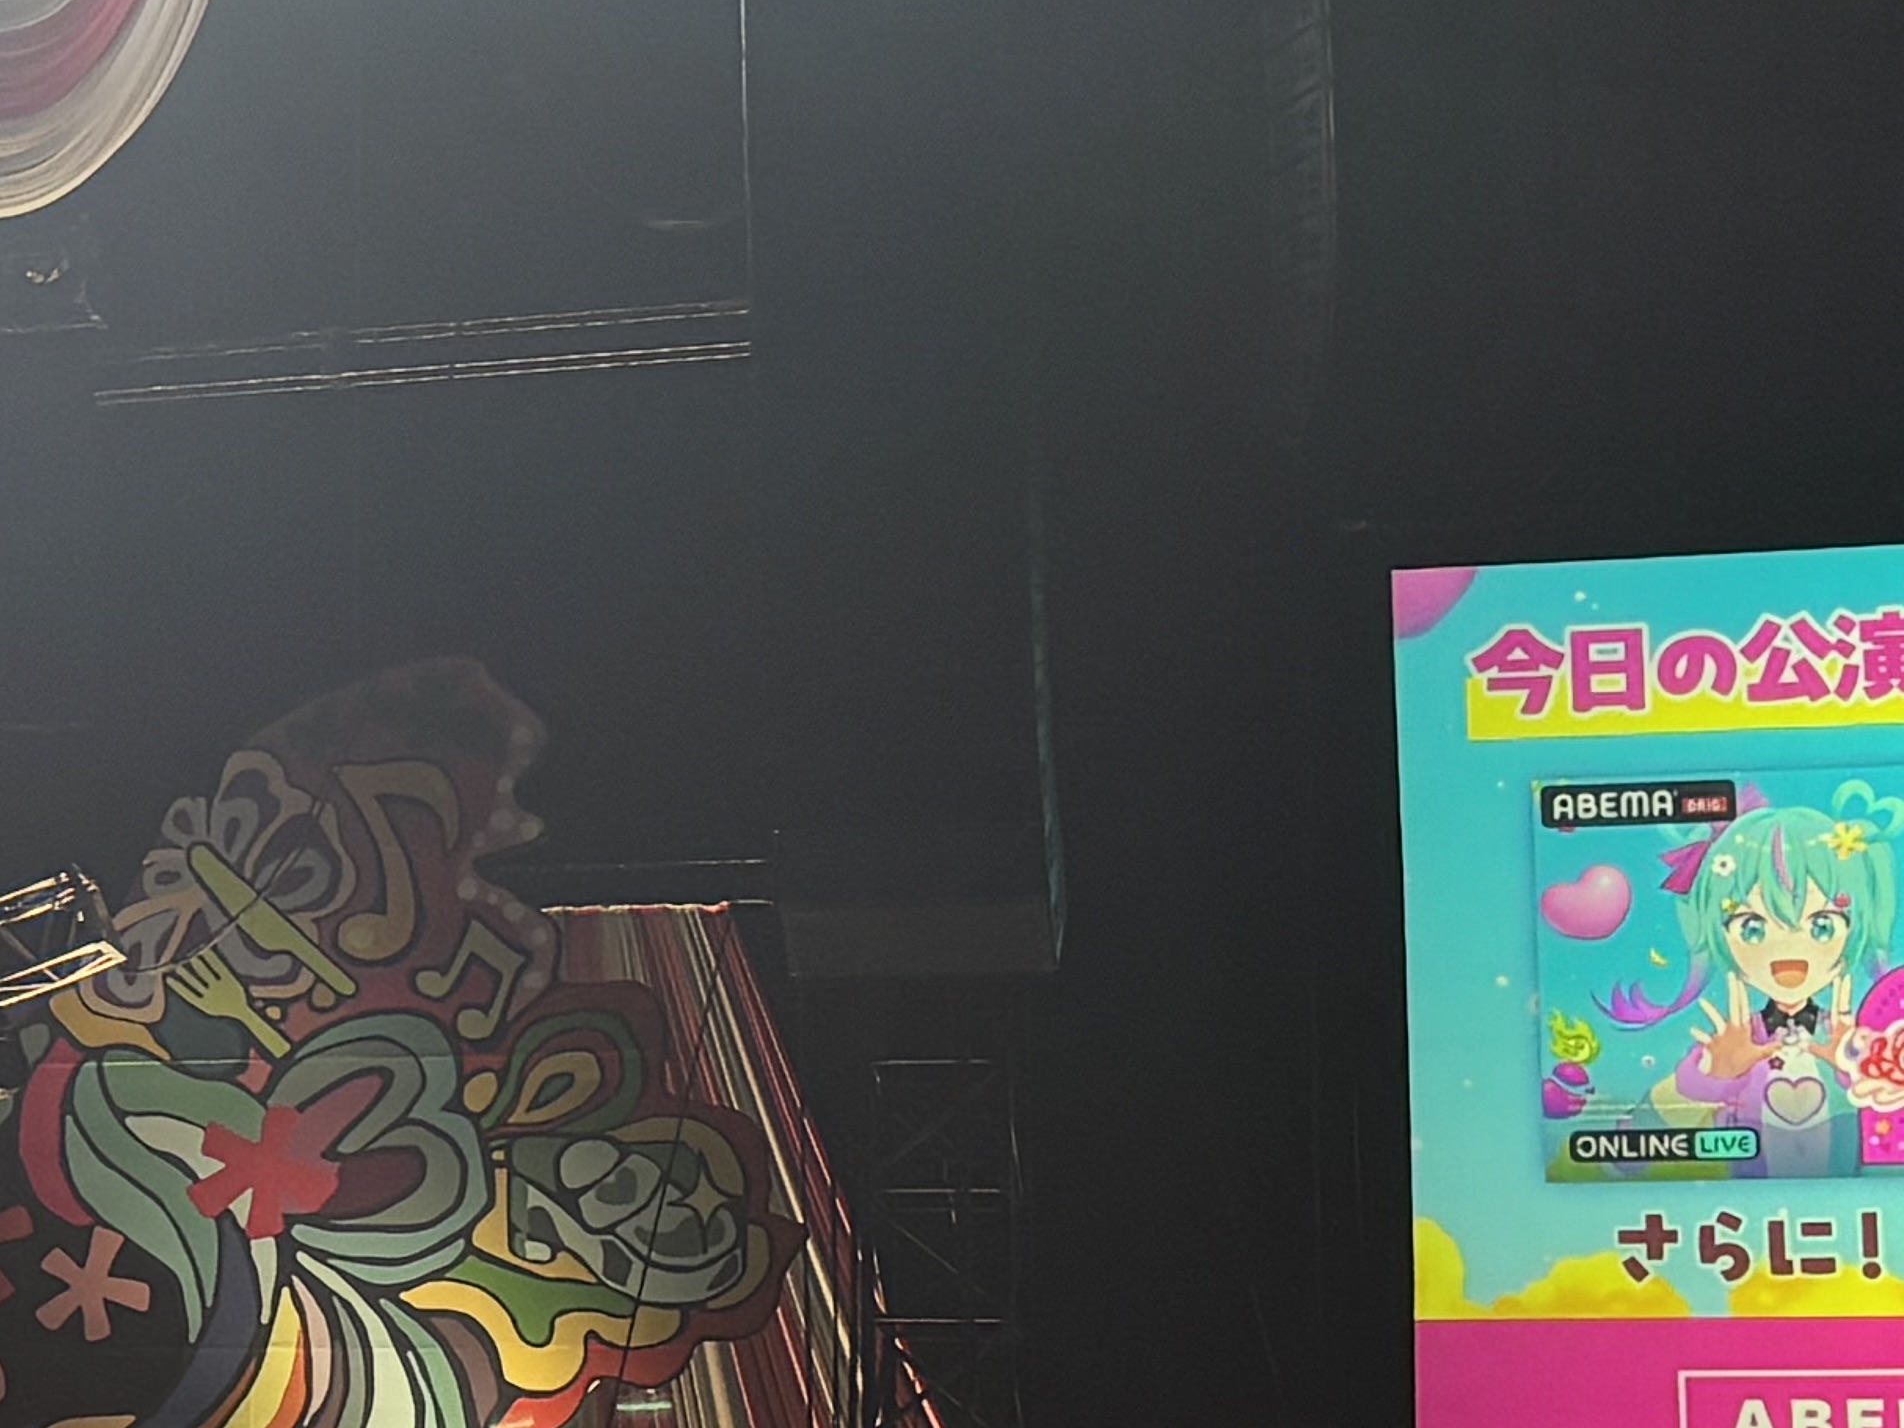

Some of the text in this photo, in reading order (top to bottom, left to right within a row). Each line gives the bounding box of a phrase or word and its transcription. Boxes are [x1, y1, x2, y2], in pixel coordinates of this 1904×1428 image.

[1552, 789, 1674, 820] ABEMA
[1576, 1133, 1750, 1158] ONLINE LIVE
[1617, 1210, 1882, 1284] さらに！
